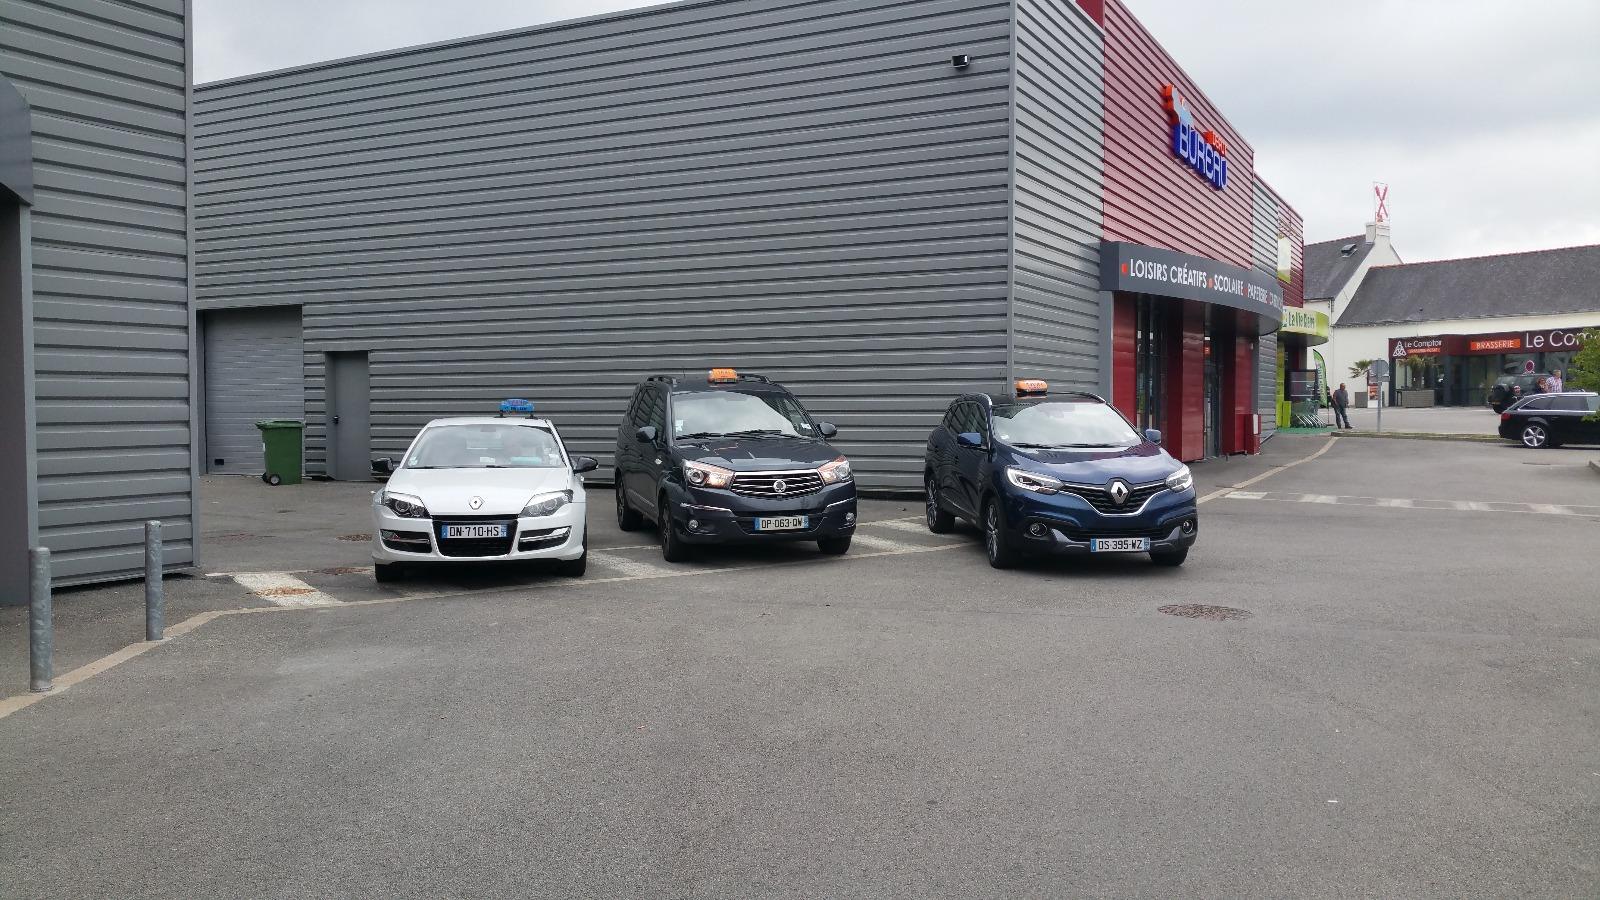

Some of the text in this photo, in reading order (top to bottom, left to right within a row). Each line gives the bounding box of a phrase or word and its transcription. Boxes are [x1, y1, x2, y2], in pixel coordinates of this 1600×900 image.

[1179, 121, 1228, 191] BUREAU
[1130, 259, 1168, 282] LOISIRS
[1170, 262, 1207, 288] CRÉATIFS
[1214, 274, 1243, 296] SCOLAIRE
[1476, 340, 1514, 350] BRASSERIE
[1526, 332, 1545, 348] Le
[761, 517, 803, 529] DP-063-QW
[449, 526, 499, 537] DN-710-HS
[1098, 539, 1143, 550] DS-395-WZ
